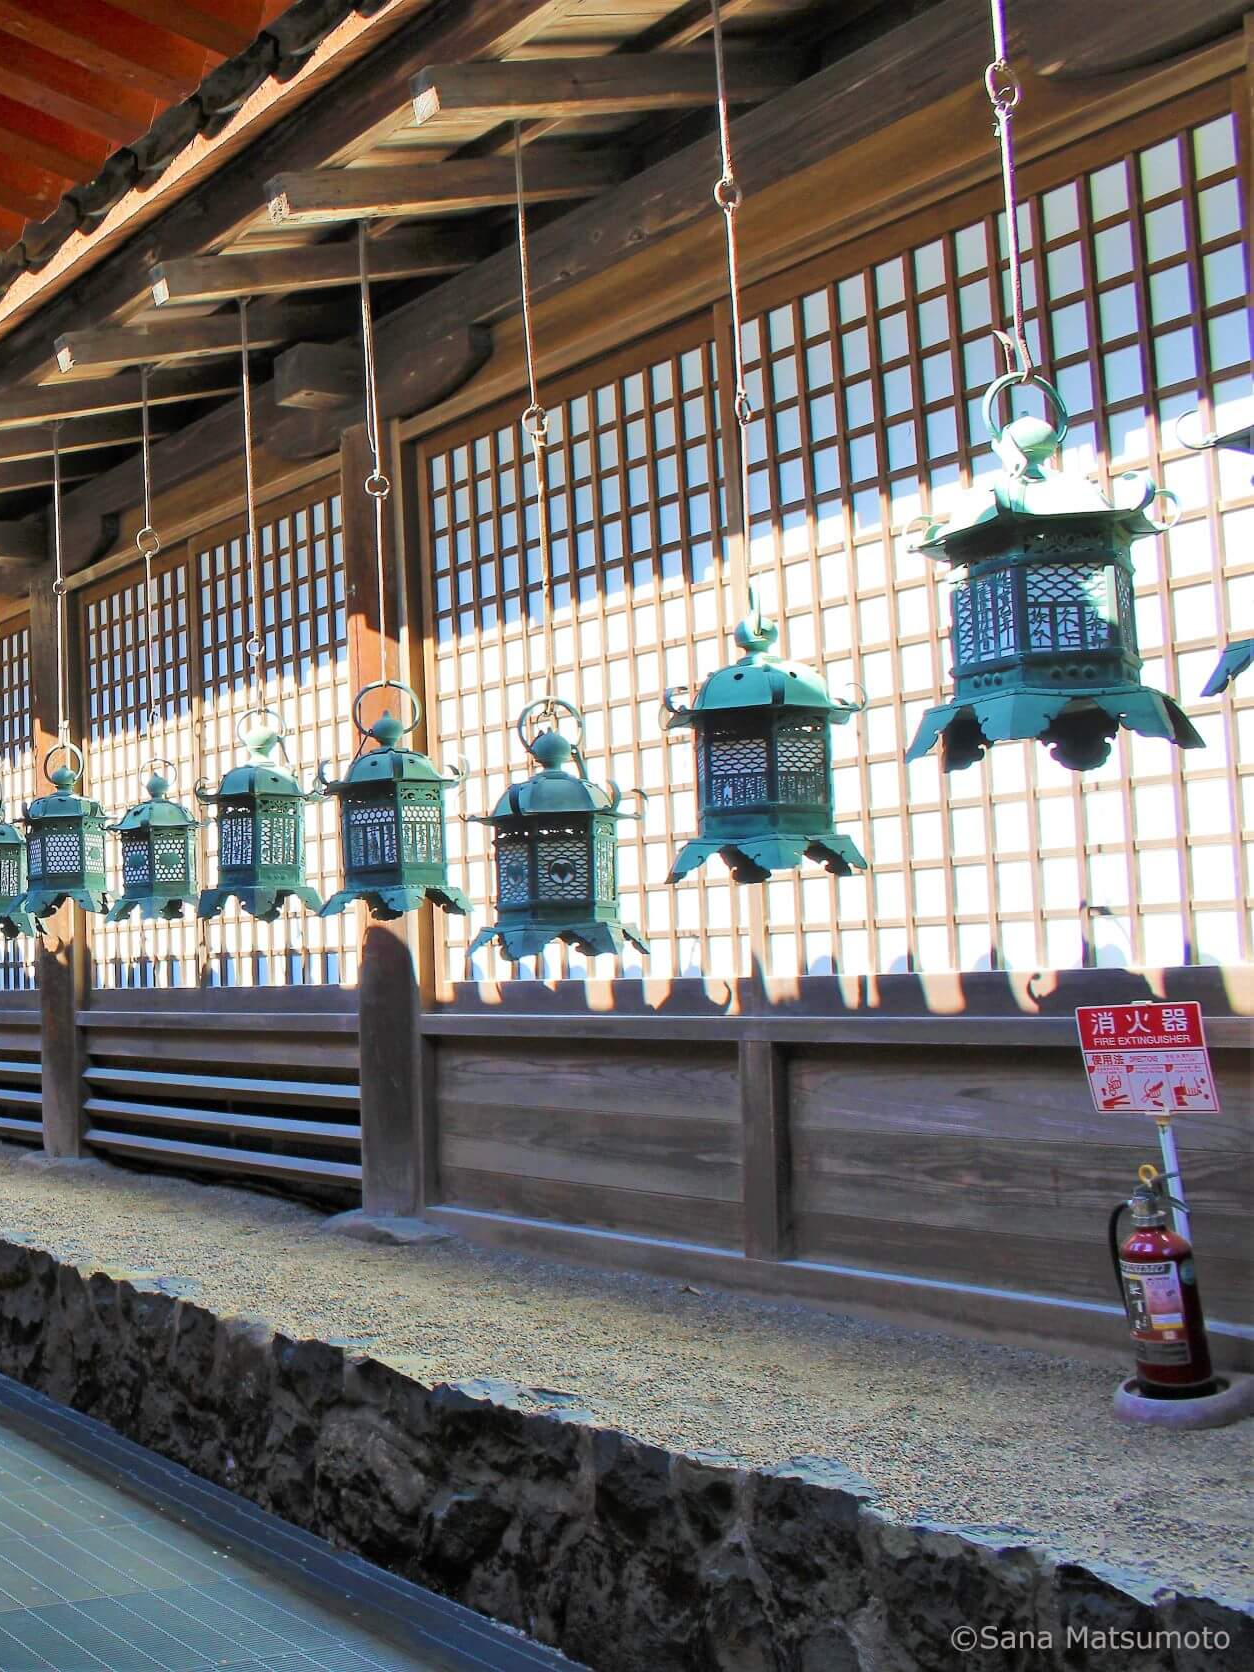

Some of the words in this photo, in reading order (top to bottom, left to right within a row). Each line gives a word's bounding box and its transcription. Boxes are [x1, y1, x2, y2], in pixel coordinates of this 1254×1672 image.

[1091, 1008, 1187, 1034] 消火器
[1094, 1037, 1116, 1046] FIRE
[1118, 1034, 1191, 1046] EXTINGUISHER
[1092, 1054, 1124, 1065] 使用法
